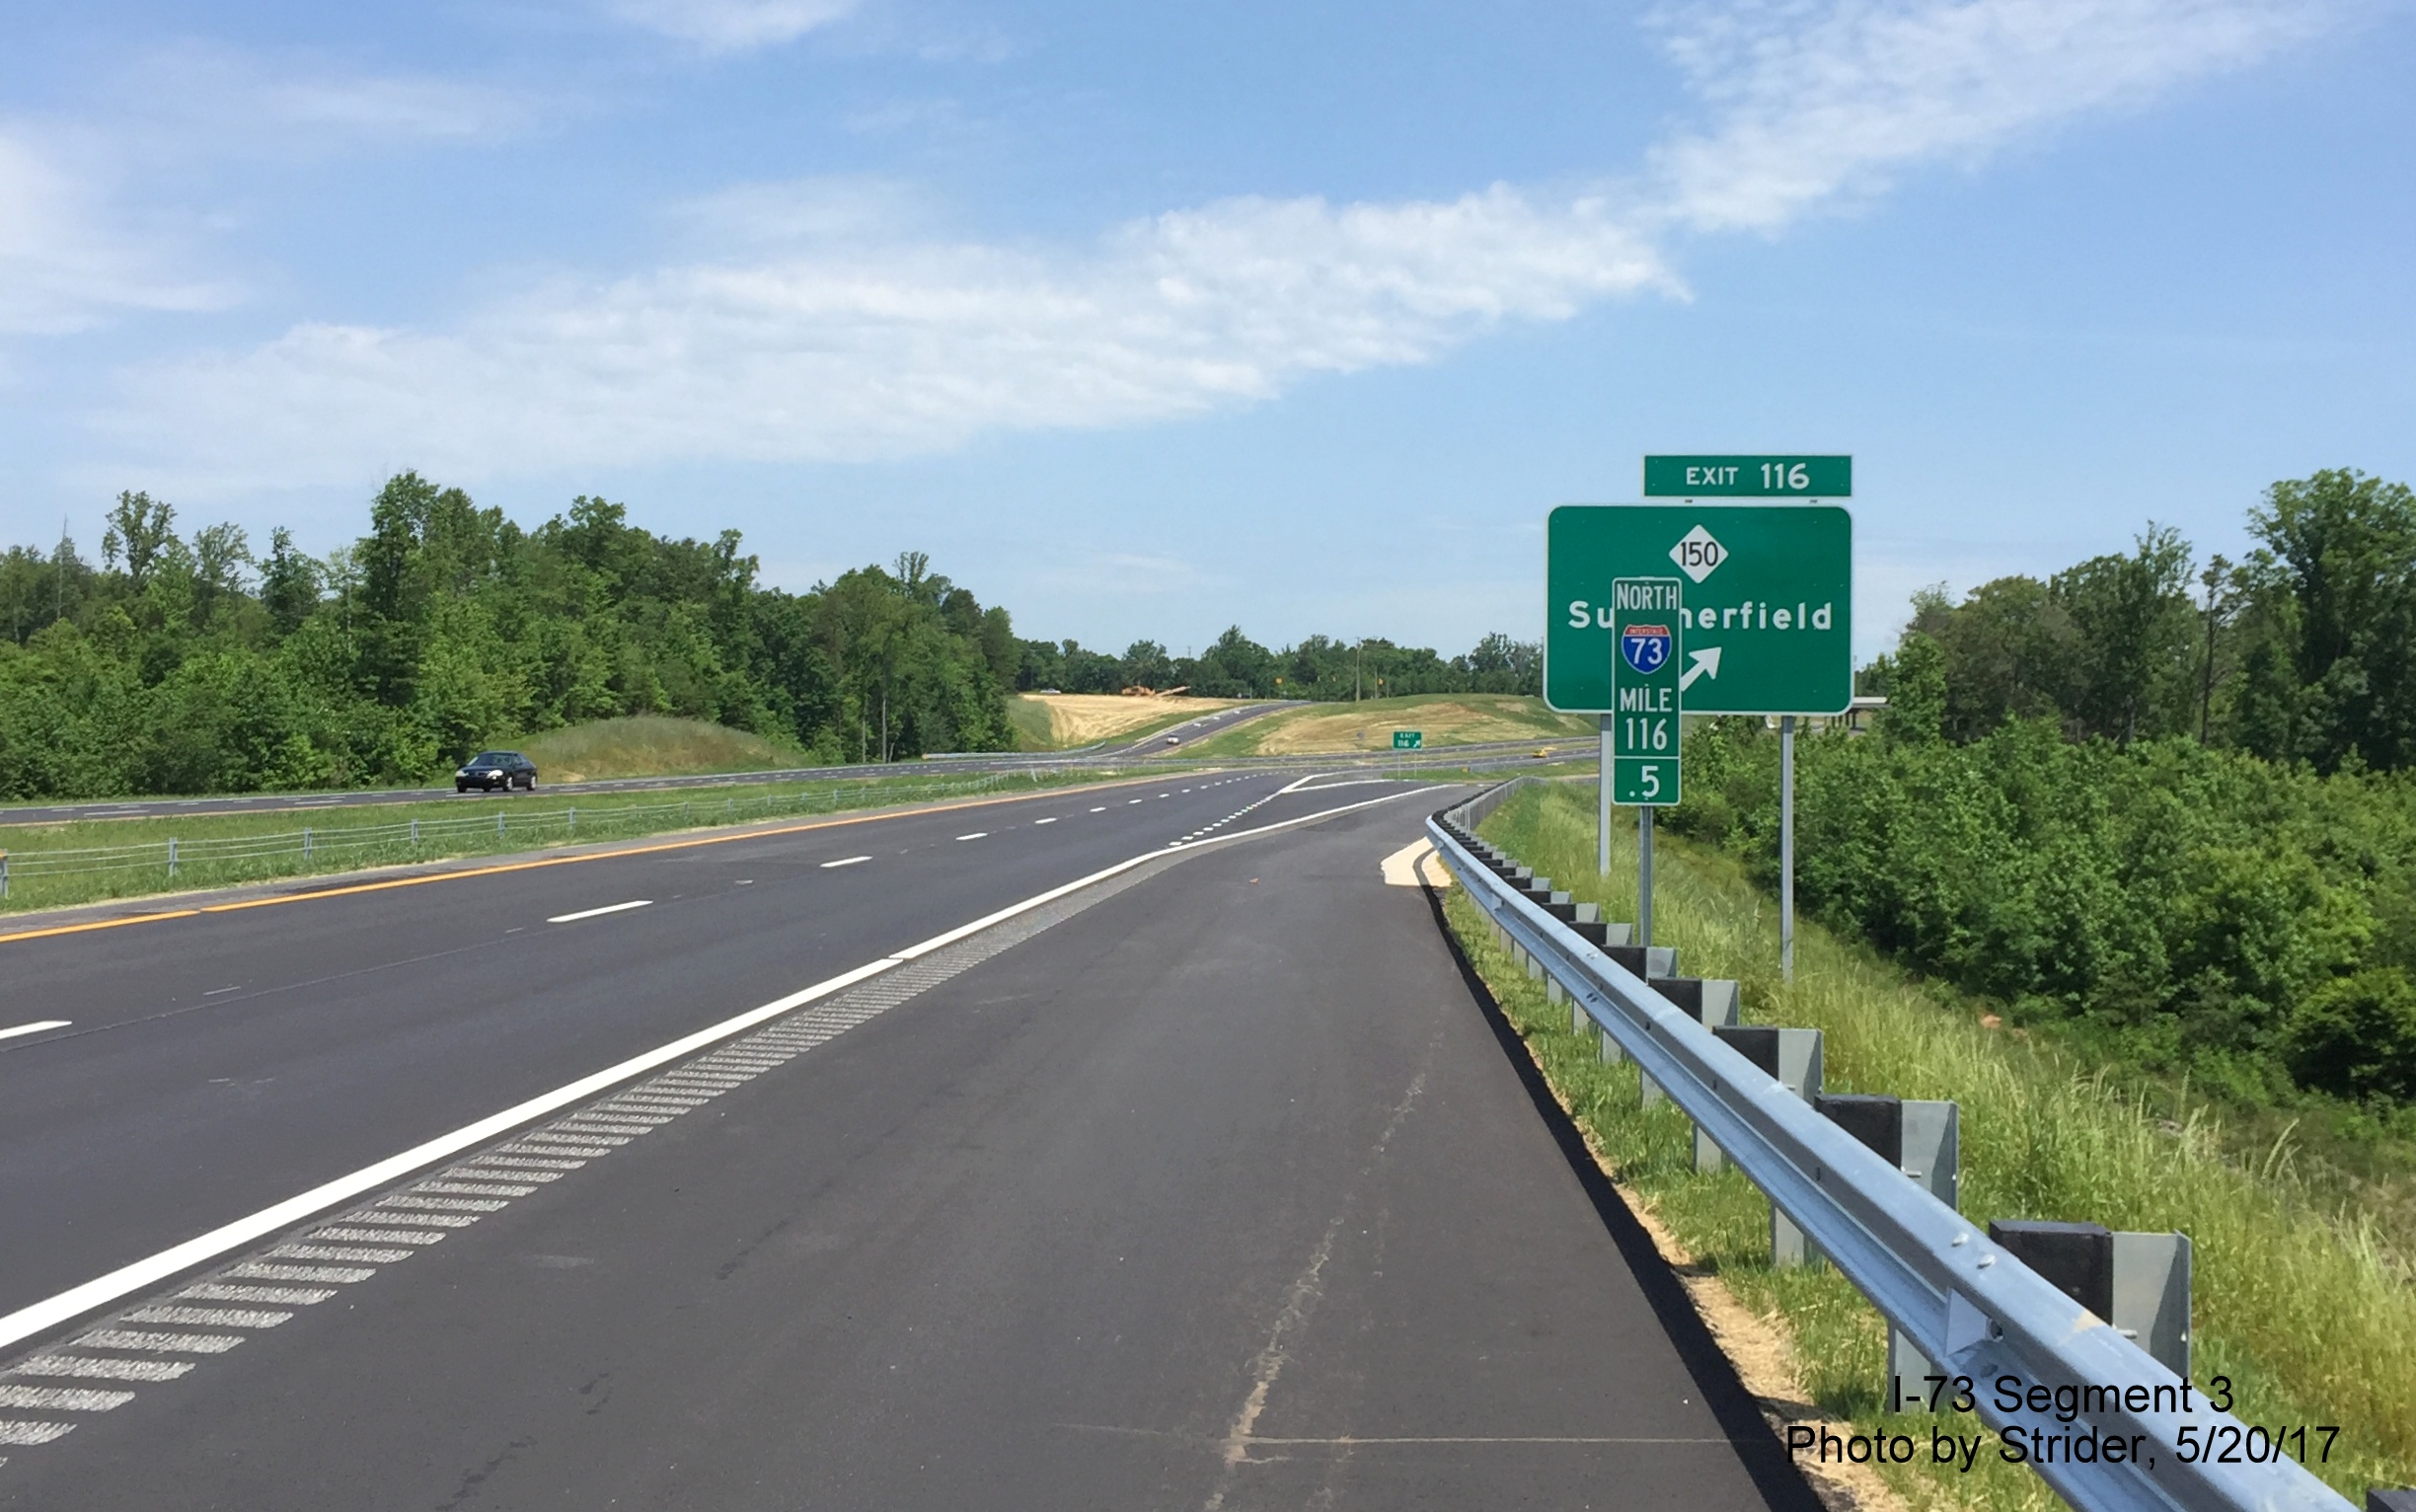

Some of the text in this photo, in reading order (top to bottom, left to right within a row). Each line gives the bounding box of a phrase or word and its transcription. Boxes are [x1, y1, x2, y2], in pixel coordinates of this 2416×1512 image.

[1686, 463, 1810, 490] EXIT 116
[1680, 541, 1719, 567] 150
[1617, 582, 1678, 611] NORTH
[1567, 600, 1832, 631] Suerfield
[1630, 638, 1663, 665] 73
[1620, 687, 1673, 713] MILE
[1625, 718, 1668, 750] 116
[1629, 765, 1660, 797] .5
